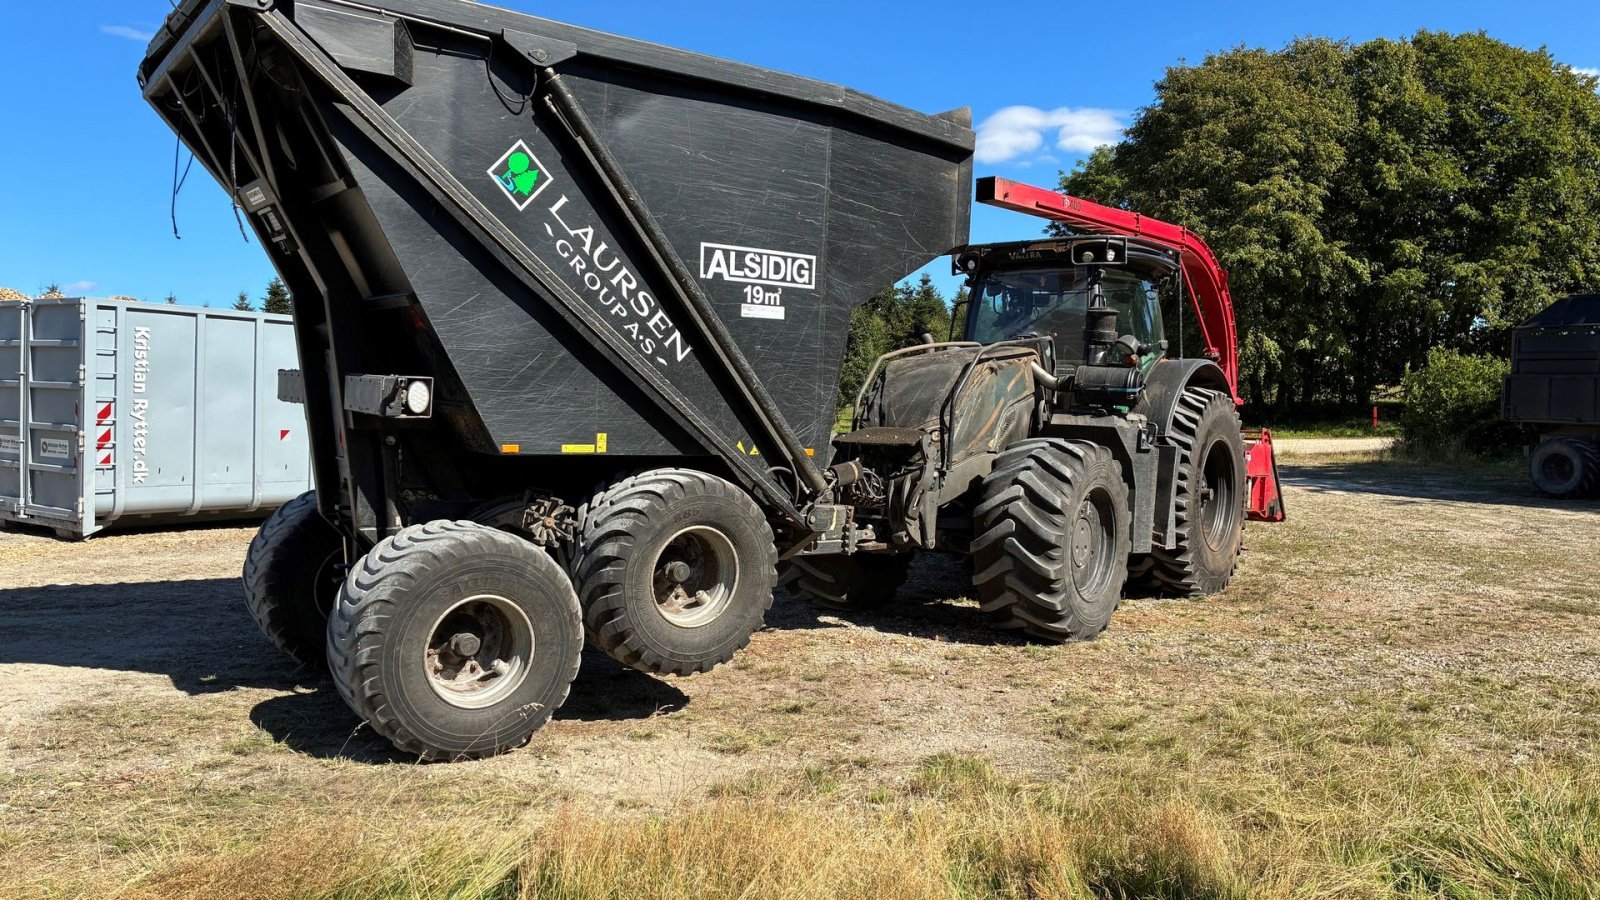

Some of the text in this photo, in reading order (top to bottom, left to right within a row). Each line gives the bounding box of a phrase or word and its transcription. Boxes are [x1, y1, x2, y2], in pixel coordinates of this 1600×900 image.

[549, 194, 692, 362] LAURSEN
[555, 239, 628, 318] GROUP
[706, 249, 810, 284] ALSIDIG
[130, 326, 151, 484] Kristian Rytter.dk
